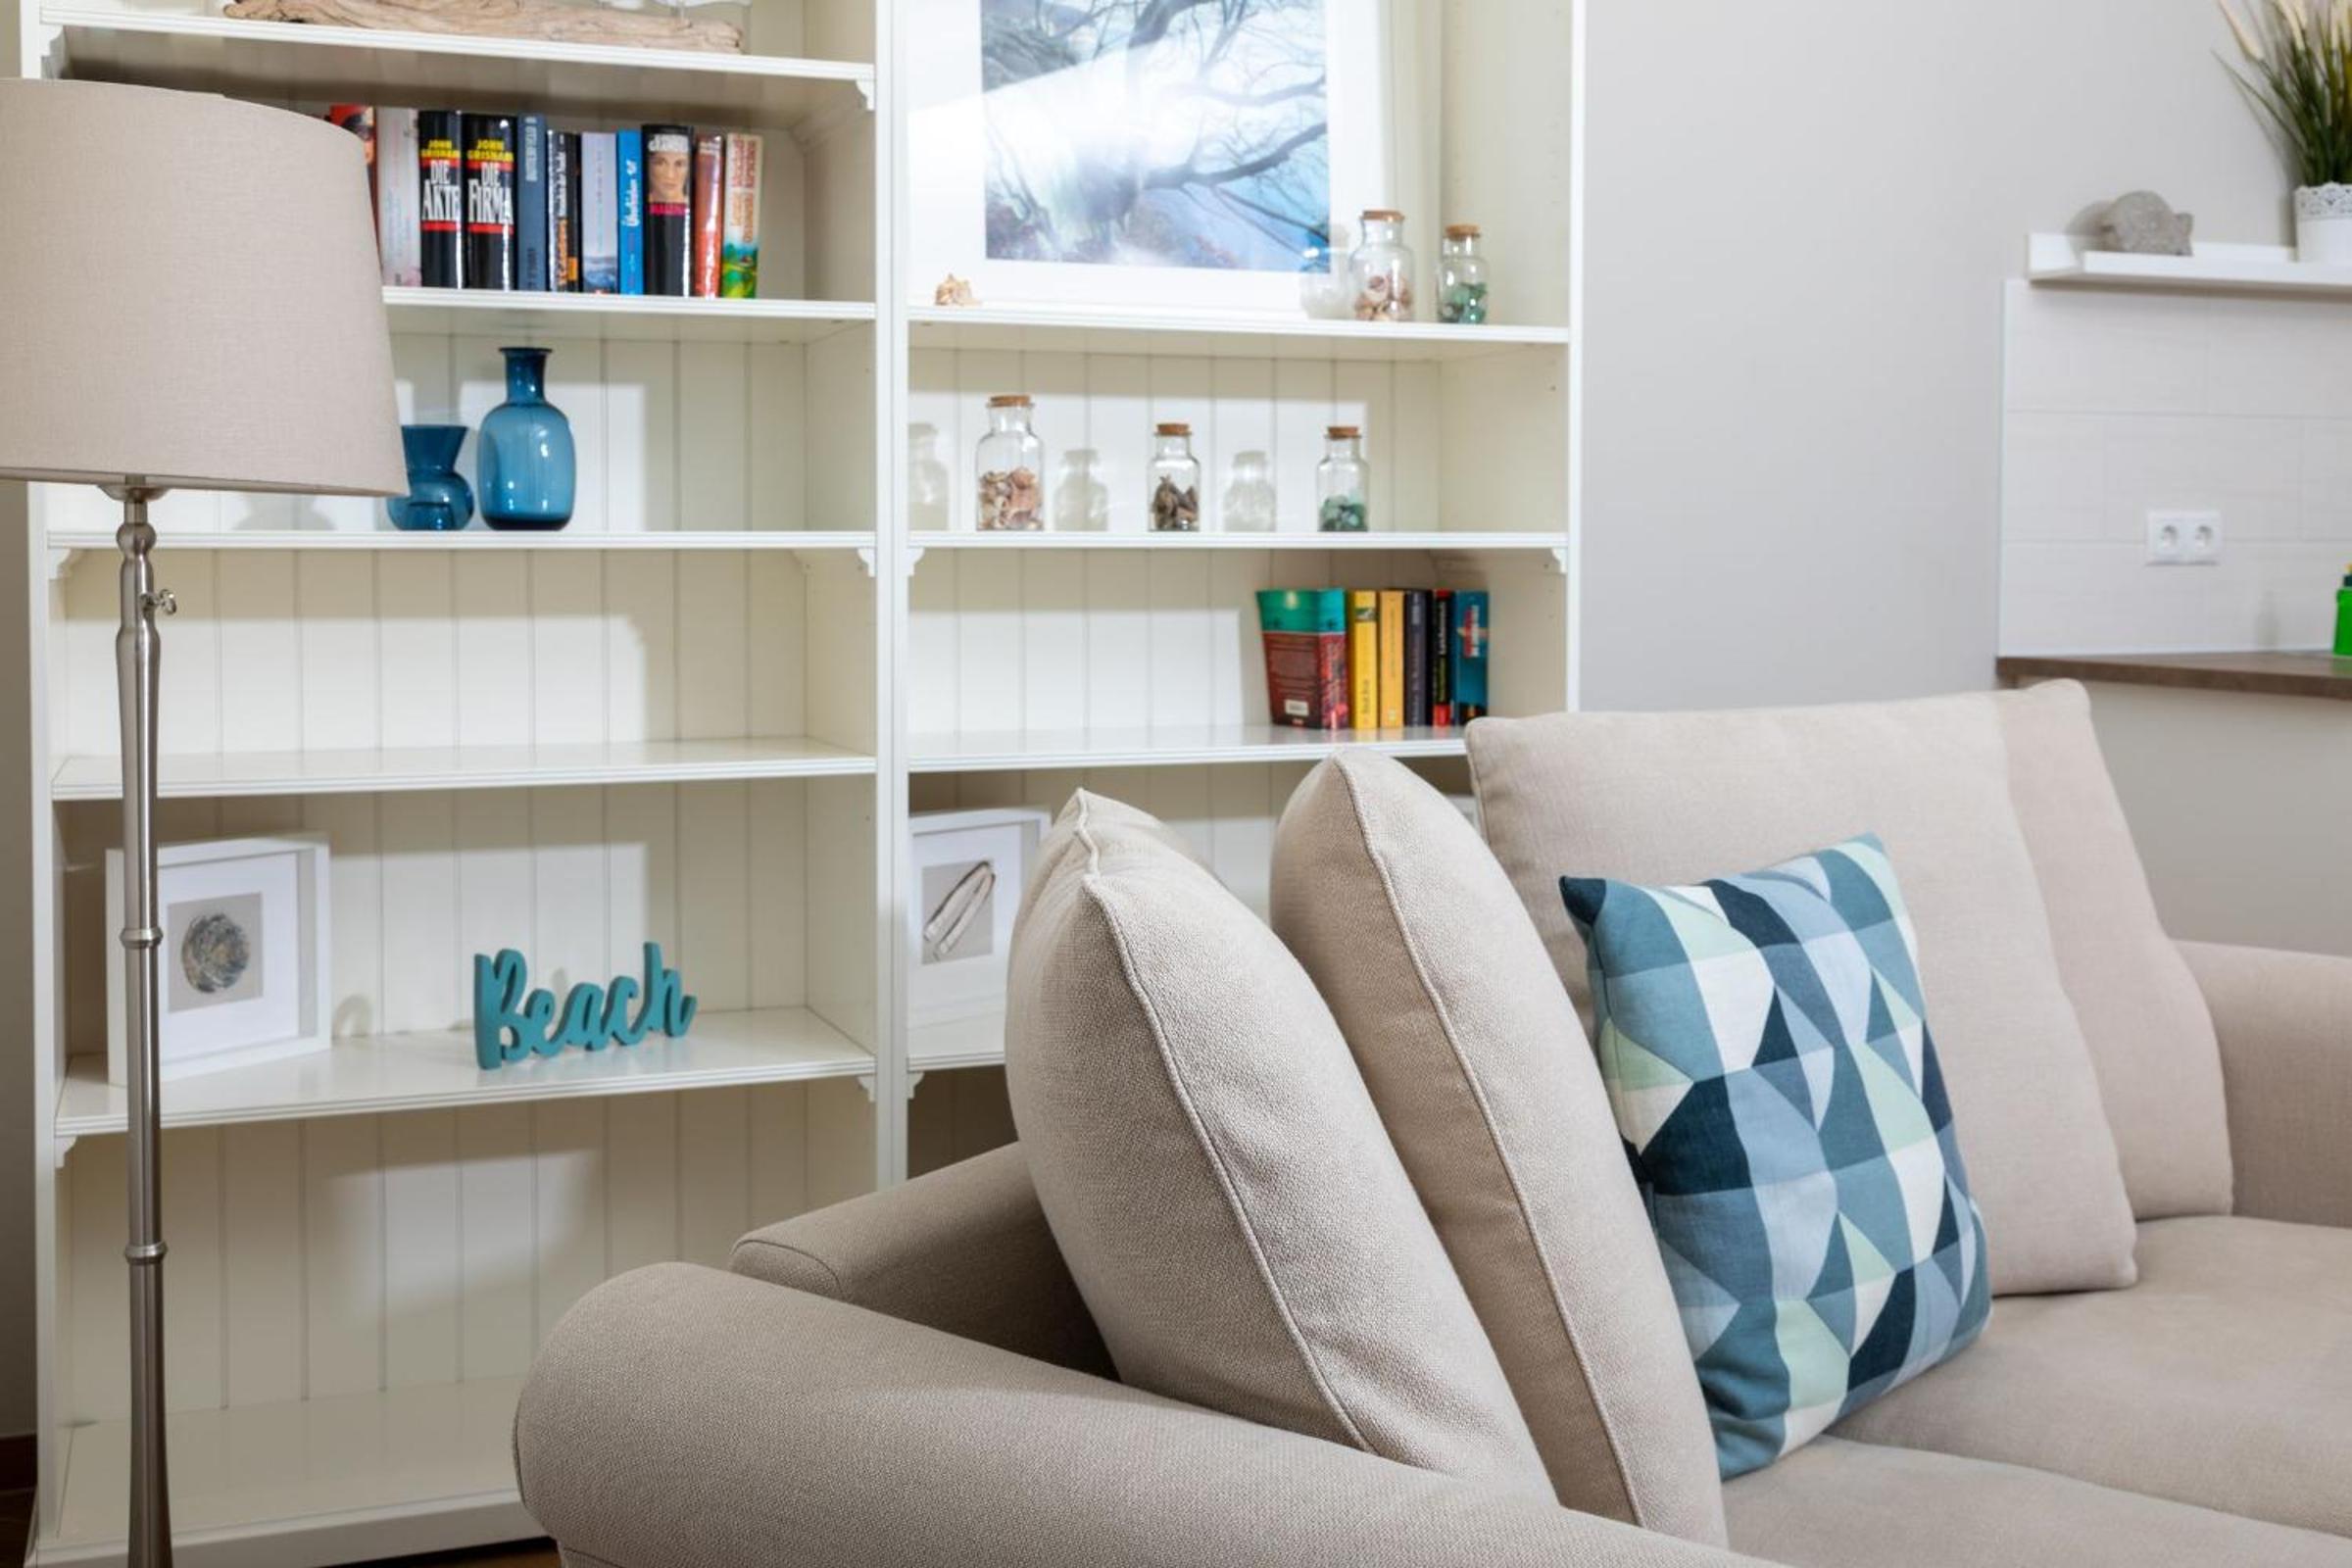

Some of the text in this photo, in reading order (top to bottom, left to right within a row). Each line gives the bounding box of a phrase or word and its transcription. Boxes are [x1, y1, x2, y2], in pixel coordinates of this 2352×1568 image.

[428, 139, 452, 149] JOHN
[476, 139, 504, 150] JOHN
[467, 151, 514, 162] GRISHAM
[430, 160, 451, 184] DIE
[481, 162, 501, 186] DIE
[421, 179, 461, 220] AKTE
[468, 178, 514, 224] FIRMA
[474, 941, 698, 1070] Beach
